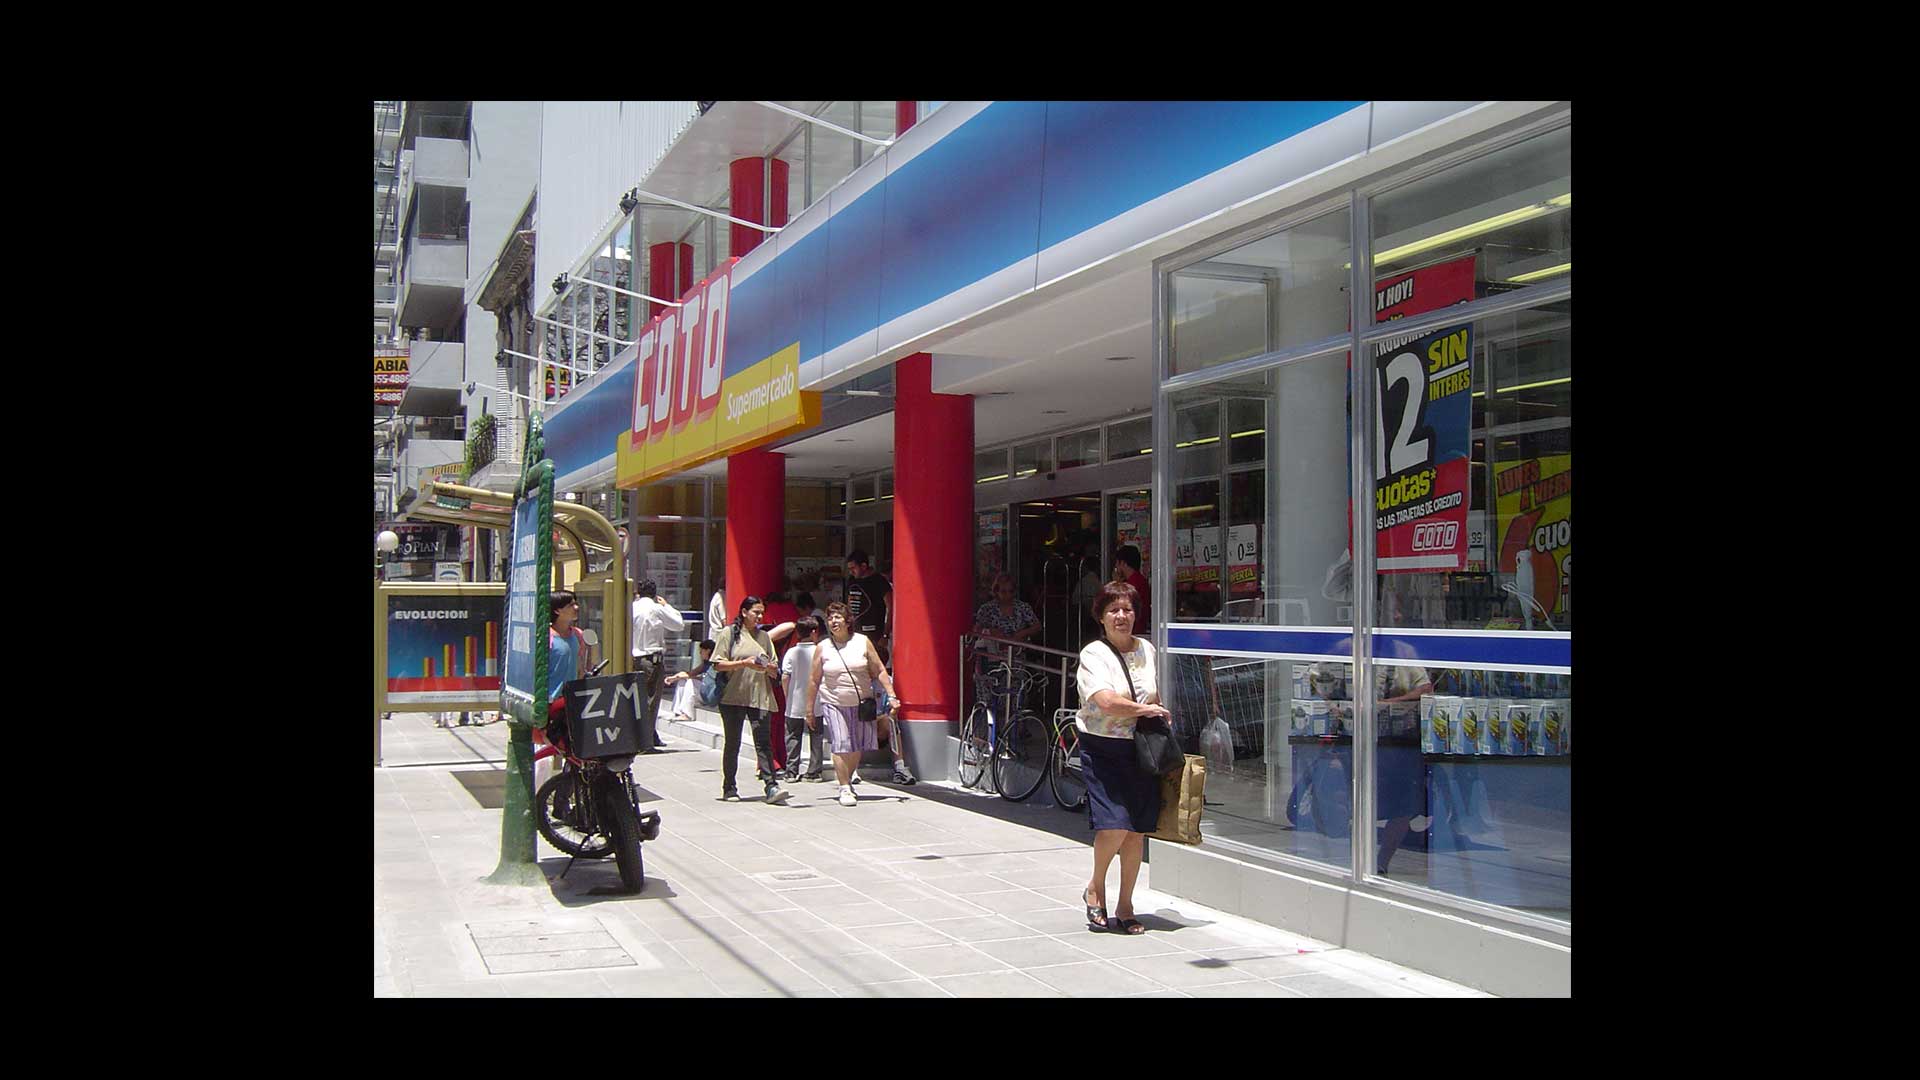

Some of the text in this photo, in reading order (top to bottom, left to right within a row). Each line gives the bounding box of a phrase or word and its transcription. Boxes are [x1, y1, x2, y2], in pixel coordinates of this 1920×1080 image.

[1386, 277, 1414, 307] HOY!
[634, 273, 729, 433] COTO
[1427, 329, 1469, 374] SIN
[727, 364, 796, 425] Supermercado
[1428, 369, 1471, 402] INTERES
[1498, 459, 1540, 497] LUNES
[1396, 504, 1425, 524] TARJETAS
[1425, 500, 1434, 514] DE
[1433, 492, 1462, 512] CREDITO
[1412, 522, 1459, 551] COTO
[394, 610, 469, 620] EVOLUCION
[574, 681, 642, 721] ZM
